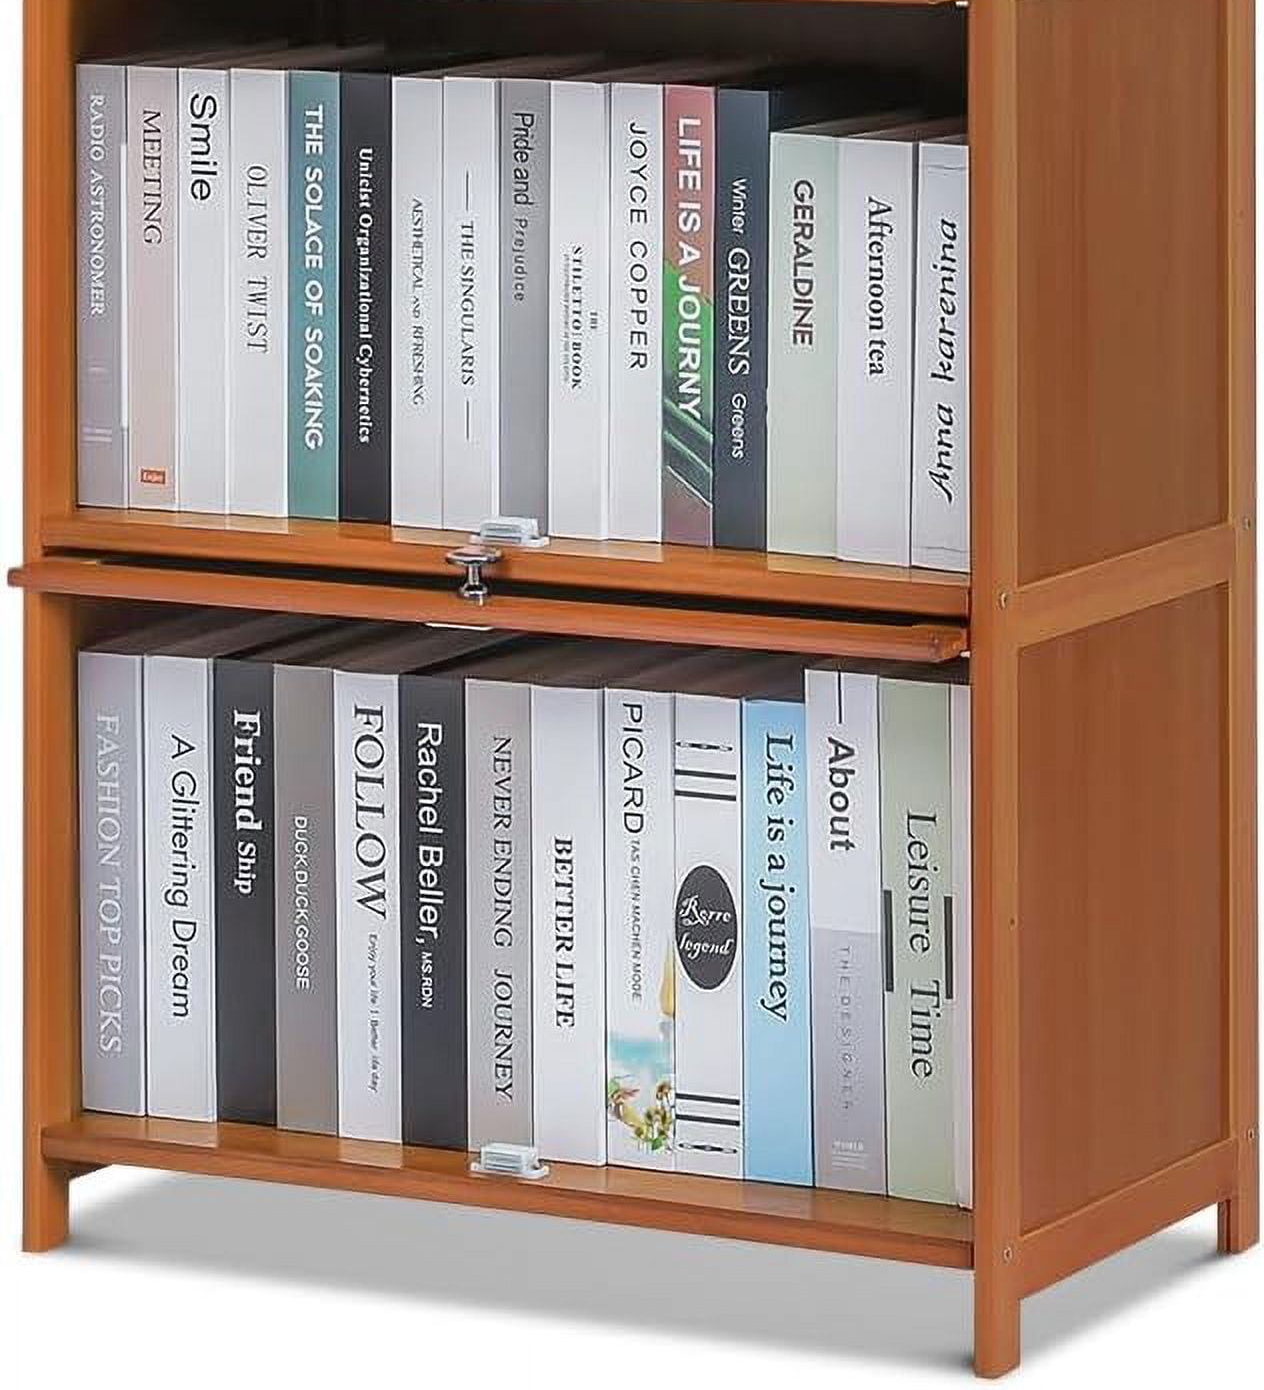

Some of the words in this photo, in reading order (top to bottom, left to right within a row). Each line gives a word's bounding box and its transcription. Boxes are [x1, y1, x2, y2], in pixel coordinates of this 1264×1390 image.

[90, 95, 104, 161] RADIO
[190, 94, 217, 201] Smile
[305, 106, 322, 154] THE
[514, 113, 534, 162] Pride
[629, 122, 647, 224] JOYCE
[678, 117, 701, 200] LIFE
[143, 110, 162, 245] MEETING
[246, 164, 266, 259] OLIVER
[305, 167, 322, 269] SOLACE
[359, 147, 372, 208] Unicist
[514, 167, 534, 206] and
[678, 204, 701, 233] IS
[732, 178, 746, 234] Winter
[91, 168, 105, 315] ASTRONOMER
[355, 213, 372, 336] Organizational
[462, 220, 473, 263] THE
[514, 219, 528, 301] Prejudice
[678, 242, 701, 267] A
[793, 179, 814, 346] GERALDINE
[868, 197, 893, 331] Afternoon
[248, 276, 268, 354] TWIST
[305, 280, 322, 315] OF
[462, 265, 474, 386] SINGULARIS
[629, 241, 647, 370] COPPER
[728, 248, 750, 375] GREENS
[931, 219, 956, 382] karenina
[305, 328, 324, 450] SOAKING
[355, 341, 372, 444] Cybernetics
[571, 342, 583, 388] BOOK
[679, 275, 703, 419] JOURNY
[868, 337, 885, 376] tea
[732, 394, 746, 458] Greens
[929, 404, 953, 503] Anna
[97, 714, 122, 867] FASHION
[171, 734, 195, 759] A
[234, 711, 262, 831] Friend
[416, 723, 443, 833] Rachel
[494, 736, 512, 829] NEVER
[622, 704, 643, 834] PICARD
[766, 734, 794, 807] Life
[163, 771, 200, 908] Glittering
[353, 705, 387, 919] FOLLOW
[767, 816, 794, 846] is
[827, 737, 856, 852] About
[235, 842, 256, 895] Ship
[416, 847, 445, 944] Beller,
[495, 840, 512, 946] ENDING
[555, 837, 574, 948] BETTER
[629, 841, 641, 860] TAS
[629, 865, 641, 900] CHEN
[767, 856, 786, 872] a
[906, 811, 937, 954] Leisure
[99, 885, 122, 946] TOP
[629, 904, 641, 958] MACHEN
[760, 879, 794, 1022] journey
[99, 957, 122, 1053] PICKS
[170, 921, 196, 1016] Dream
[422, 953, 433, 1008] MS.RDN
[555, 960, 574, 1028] LIFE
[629, 960, 642, 1002] MODE
[839, 947, 851, 988] THE
[495, 970, 514, 1100] JOURNEY
[910, 980, 938, 1079] Time
